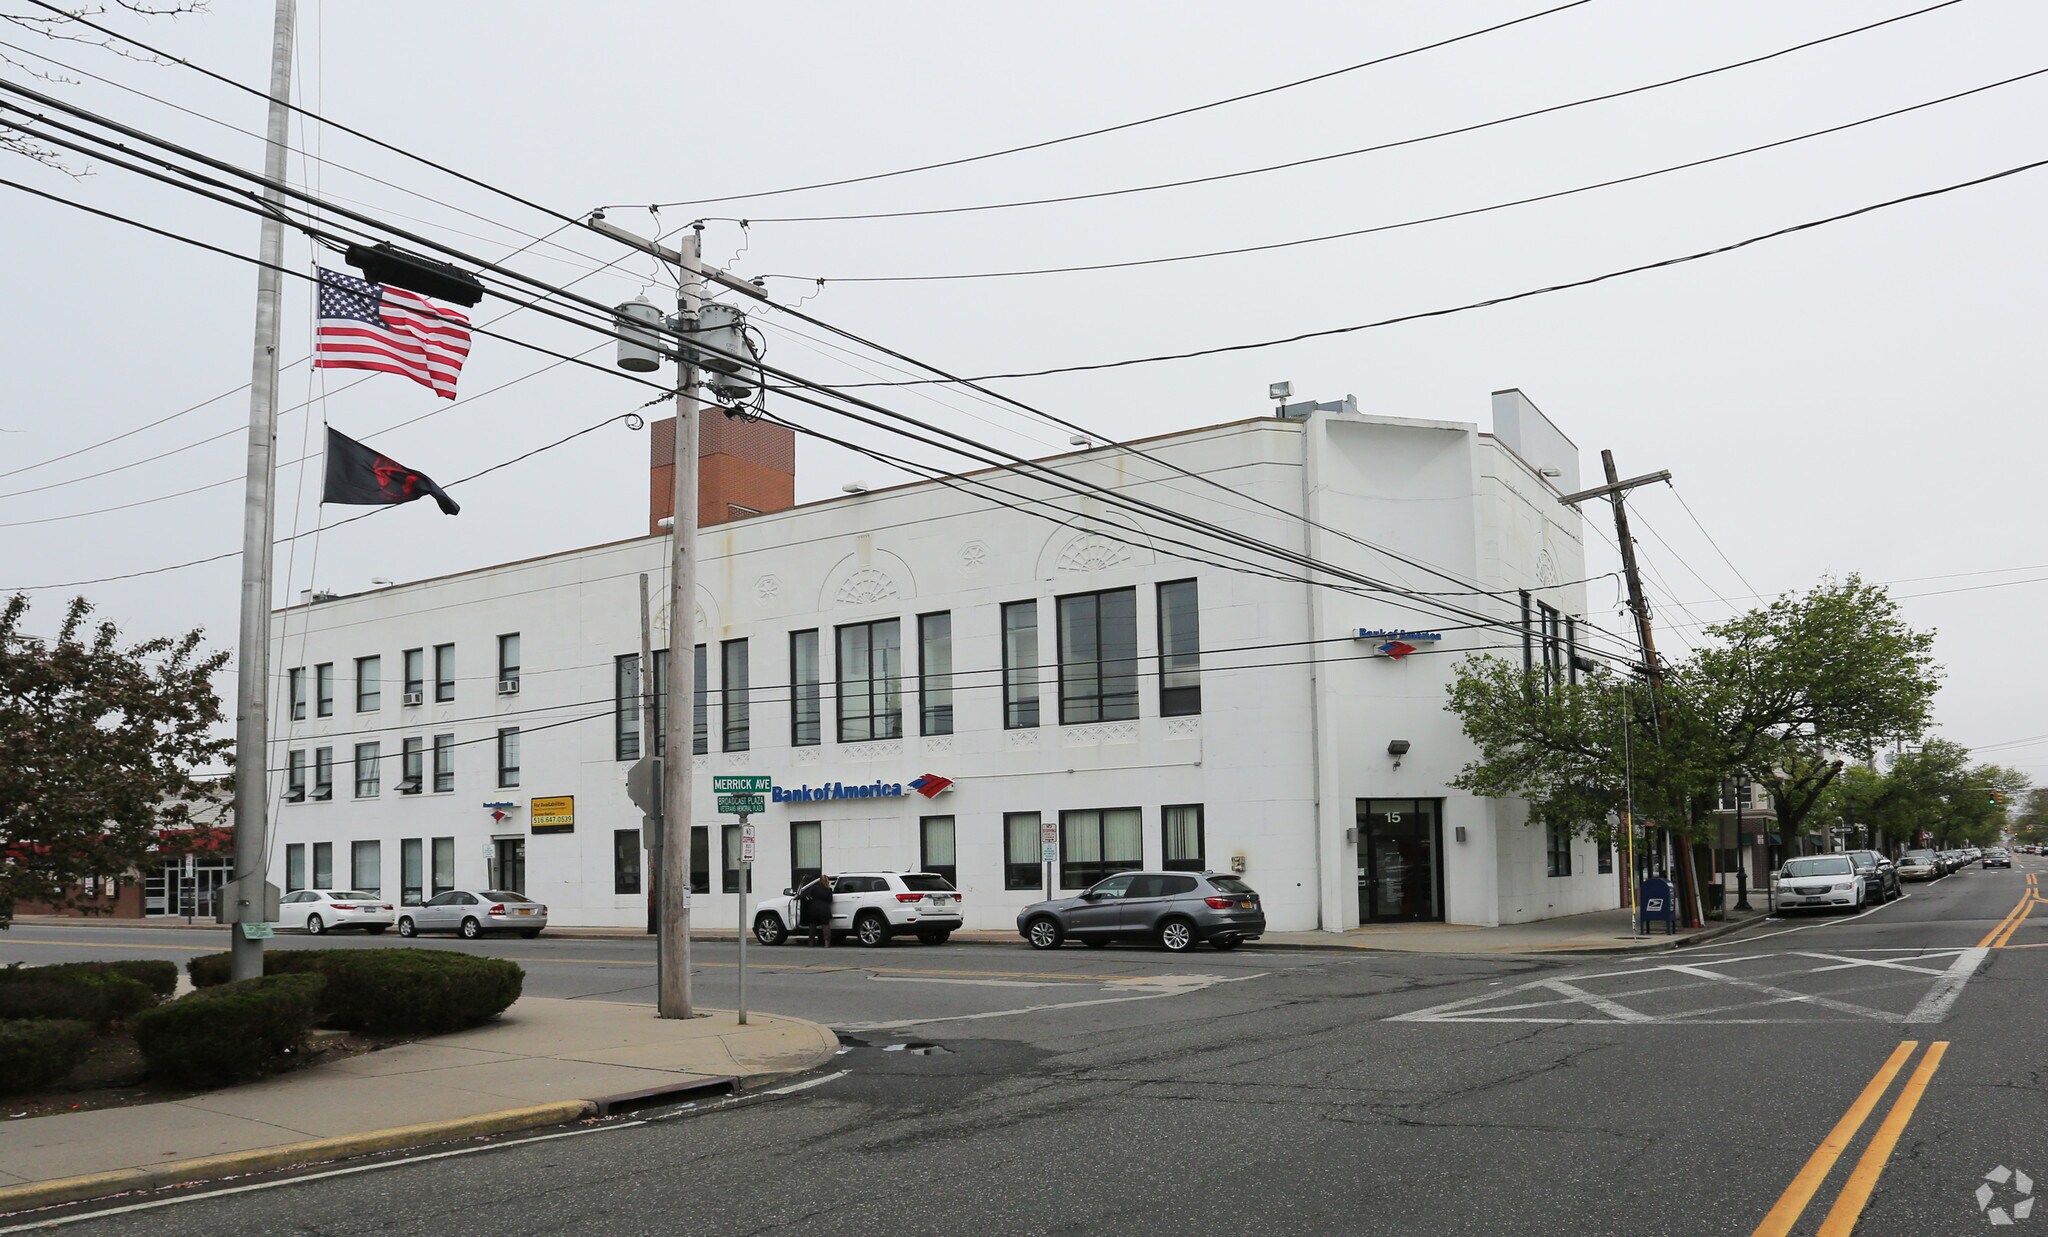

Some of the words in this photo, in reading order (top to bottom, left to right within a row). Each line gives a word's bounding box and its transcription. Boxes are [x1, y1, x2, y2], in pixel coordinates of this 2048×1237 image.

[714, 779, 752, 790] MERRICK
[755, 779, 770, 789] AVE
[772, 785, 813, 803] Bank
[813, 783, 831, 801] of
[832, 780, 902, 799] America
[718, 797, 747, 806] BROADCAST
[748, 796, 764, 805] PLAZA
[533, 816, 572, 824] 516.647.0539
[1385, 811, 1401, 823] 15
